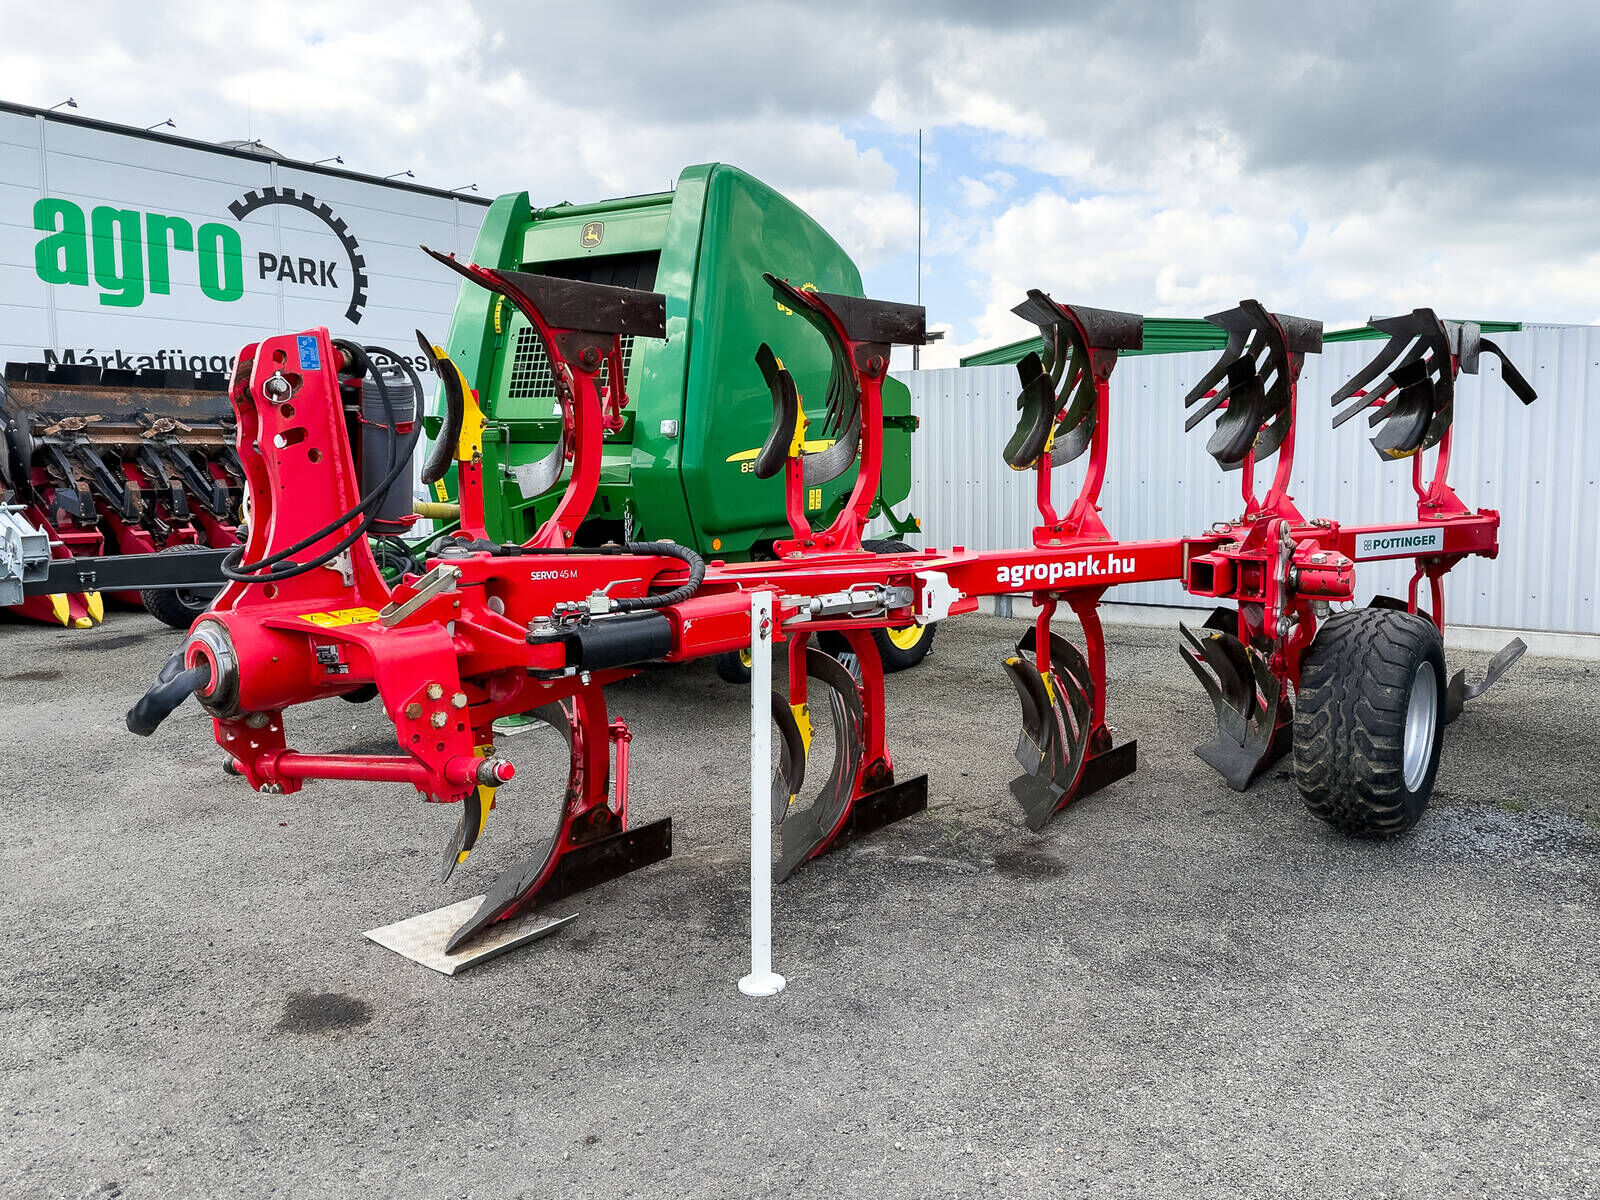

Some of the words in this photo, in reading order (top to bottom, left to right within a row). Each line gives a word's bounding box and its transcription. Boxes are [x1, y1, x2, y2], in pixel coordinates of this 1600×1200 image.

[33, 197, 243, 308] agro
[258, 251, 339, 288] PARK
[1373, 534, 1436, 550] PÖTTINGER
[530, 570, 559, 581] SERVO
[570, 569, 578, 579] M
[996, 553, 1136, 587] agropark.hu
